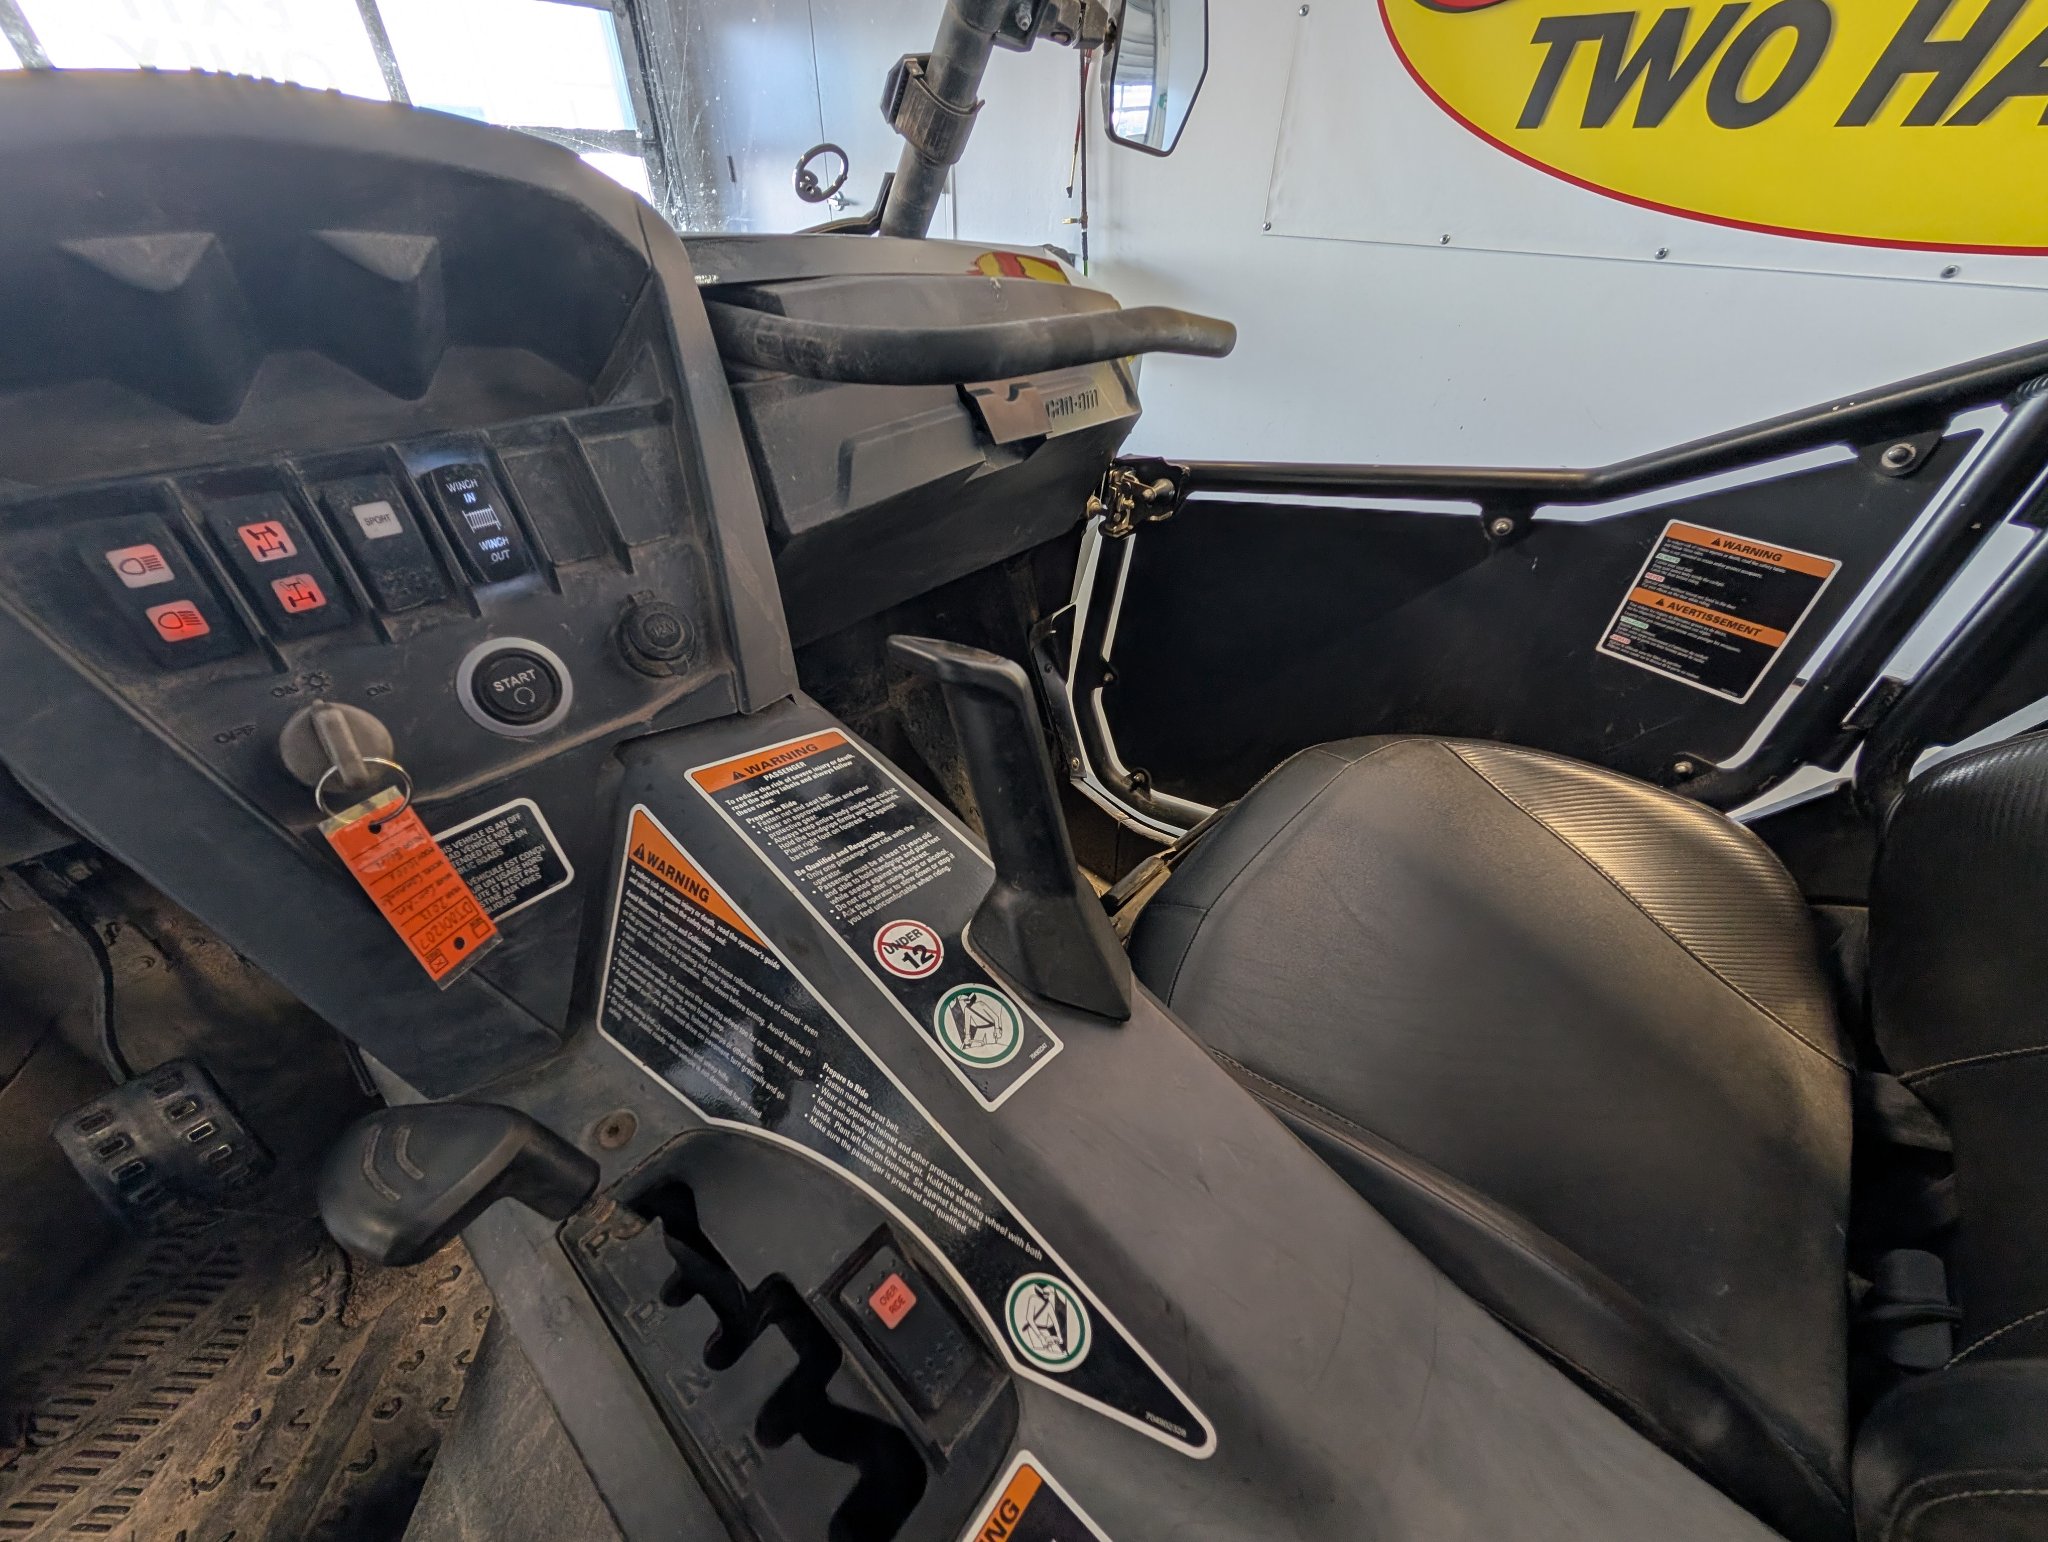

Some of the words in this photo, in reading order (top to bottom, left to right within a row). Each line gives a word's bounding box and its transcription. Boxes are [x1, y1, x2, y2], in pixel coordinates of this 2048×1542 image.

[1515, 0, 1831, 130] TWO
[446, 479, 478, 493] WINCH
[463, 491, 476, 503] IN
[364, 513, 391, 526] SPORT
[479, 537, 509, 551] WINCH
[491, 549, 510, 562] OUT
[1722, 539, 1783, 563] WARNING
[1667, 601, 1763, 637] AVERTISSEMENT
[367, 683, 392, 697] ON
[493, 669, 536, 692] START
[214, 724, 256, 743] OFF
[745, 743, 819, 775] WARNING
[762, 761, 808, 782] PASSENGER
[734, 789, 761, 803] reduce
[769, 779, 786, 789] risk
[791, 769, 813, 781] severe
[811, 762, 832, 774] injury
[758, 788, 782, 802] safety
[778, 781, 800, 793] labels
[735, 805, 757, 817] these
[745, 809, 776, 826] Prepare
[780, 799, 799, 810] Ride
[756, 814, 782, 828] Fasten
[790, 804, 823, 822] approved
[819, 795, 843, 808] helmet
[873, 801, 897, 816] against
[767, 820, 804, 840] protective
[772, 829, 801, 846] Always
[814, 814, 835, 826] entire
[847, 800, 867, 812] inside
[805, 820, 840, 839] handgrips
[451, 829, 487, 850] VEHICLE
[460, 834, 495, 855] VEHICLE
[804, 853, 837, 872] Qualified
[834, 847, 850, 858] and
[847, 829, 887, 853] Responsible
[475, 847, 504, 866] ROADS
[495, 863, 523, 882] USAGE
[521, 853, 544, 869] HORS
[806, 869, 825, 881] Only
[835, 847, 870, 867] passenger
[879, 835, 893, 845] ride
[890, 828, 906, 839] with
[817, 871, 855, 894] Passenger
[851, 863, 870, 876] must
[883, 848, 900, 859] least
[906, 837, 924, 849] years
[872, 854, 905, 875] handgrips
[913, 841, 931, 854] plant
[927, 835, 941, 845] feet
[518, 871, 542, 888] VOIES
[647, 850, 710, 903] WARNING
[828, 892, 850, 906] while
[847, 880, 872, 896] seated
[869, 868, 895, 885] against
[856, 889, 873, 900] ride
[870, 881, 888, 893] after
[884, 872, 905, 886] using
[901, 863, 922, 877] drugs
[865, 886, 896, 906] operator
[899, 875, 916, 887] slow
[913, 865, 933, 879] down
[936, 855, 952, 867] stop
[859, 907, 876, 918] feel
[872, 883, 918, 911] uncomfortable
[915, 873, 935, 887] when
[883, 929, 923, 954] UNDER
[902, 945, 934, 969] 12
[822, 1062, 848, 1086] Prepare
[853, 1084, 870, 1100] Ride
[823, 1076, 845, 1095] Fasten
[844, 1090, 859, 1105] nets
[858, 1100, 872, 1114] and
[871, 1109, 886, 1124] seat
[820, 1086, 838, 1103] Wear
[845, 1104, 876, 1131] approved
[875, 1124, 898, 1145] helmet
[897, 1140, 911, 1155] and
[910, 1149, 930, 1168] other
[928, 1162, 965, 1194] protective
[808, 1116, 827, 1134] Make
[826, 1130, 841, 1144] sure
[840, 1138, 852, 1151] the
[850, 1148, 885, 1177] passenger
[891, 1174, 923, 1203] prepared
[922, 1196, 937, 1211] and
[833, 1121, 851, 1138] Plant
[850, 1132, 862, 1146] left
[861, 1140, 875, 1155] foot
[912, 1177, 924, 1190] Sit
[922, 1184, 950, 1210] against
[816, 1096, 833, 1114] Keep
[832, 1107, 851, 1125] entire
[850, 1120, 867, 1138] body
[866, 1131, 887, 1150] inside
[886, 1145, 898, 1158] the
[926, 1173, 943, 1190] Hold
[942, 1185, 956, 1199] the
[954, 1193, 985, 1221] steering
[984, 1214, 1008, 1236] wheel
[1007, 1230, 1026, 1248] with
[1024, 1242, 1043, 1261] both
[880, 1285, 897, 1305] OVER
